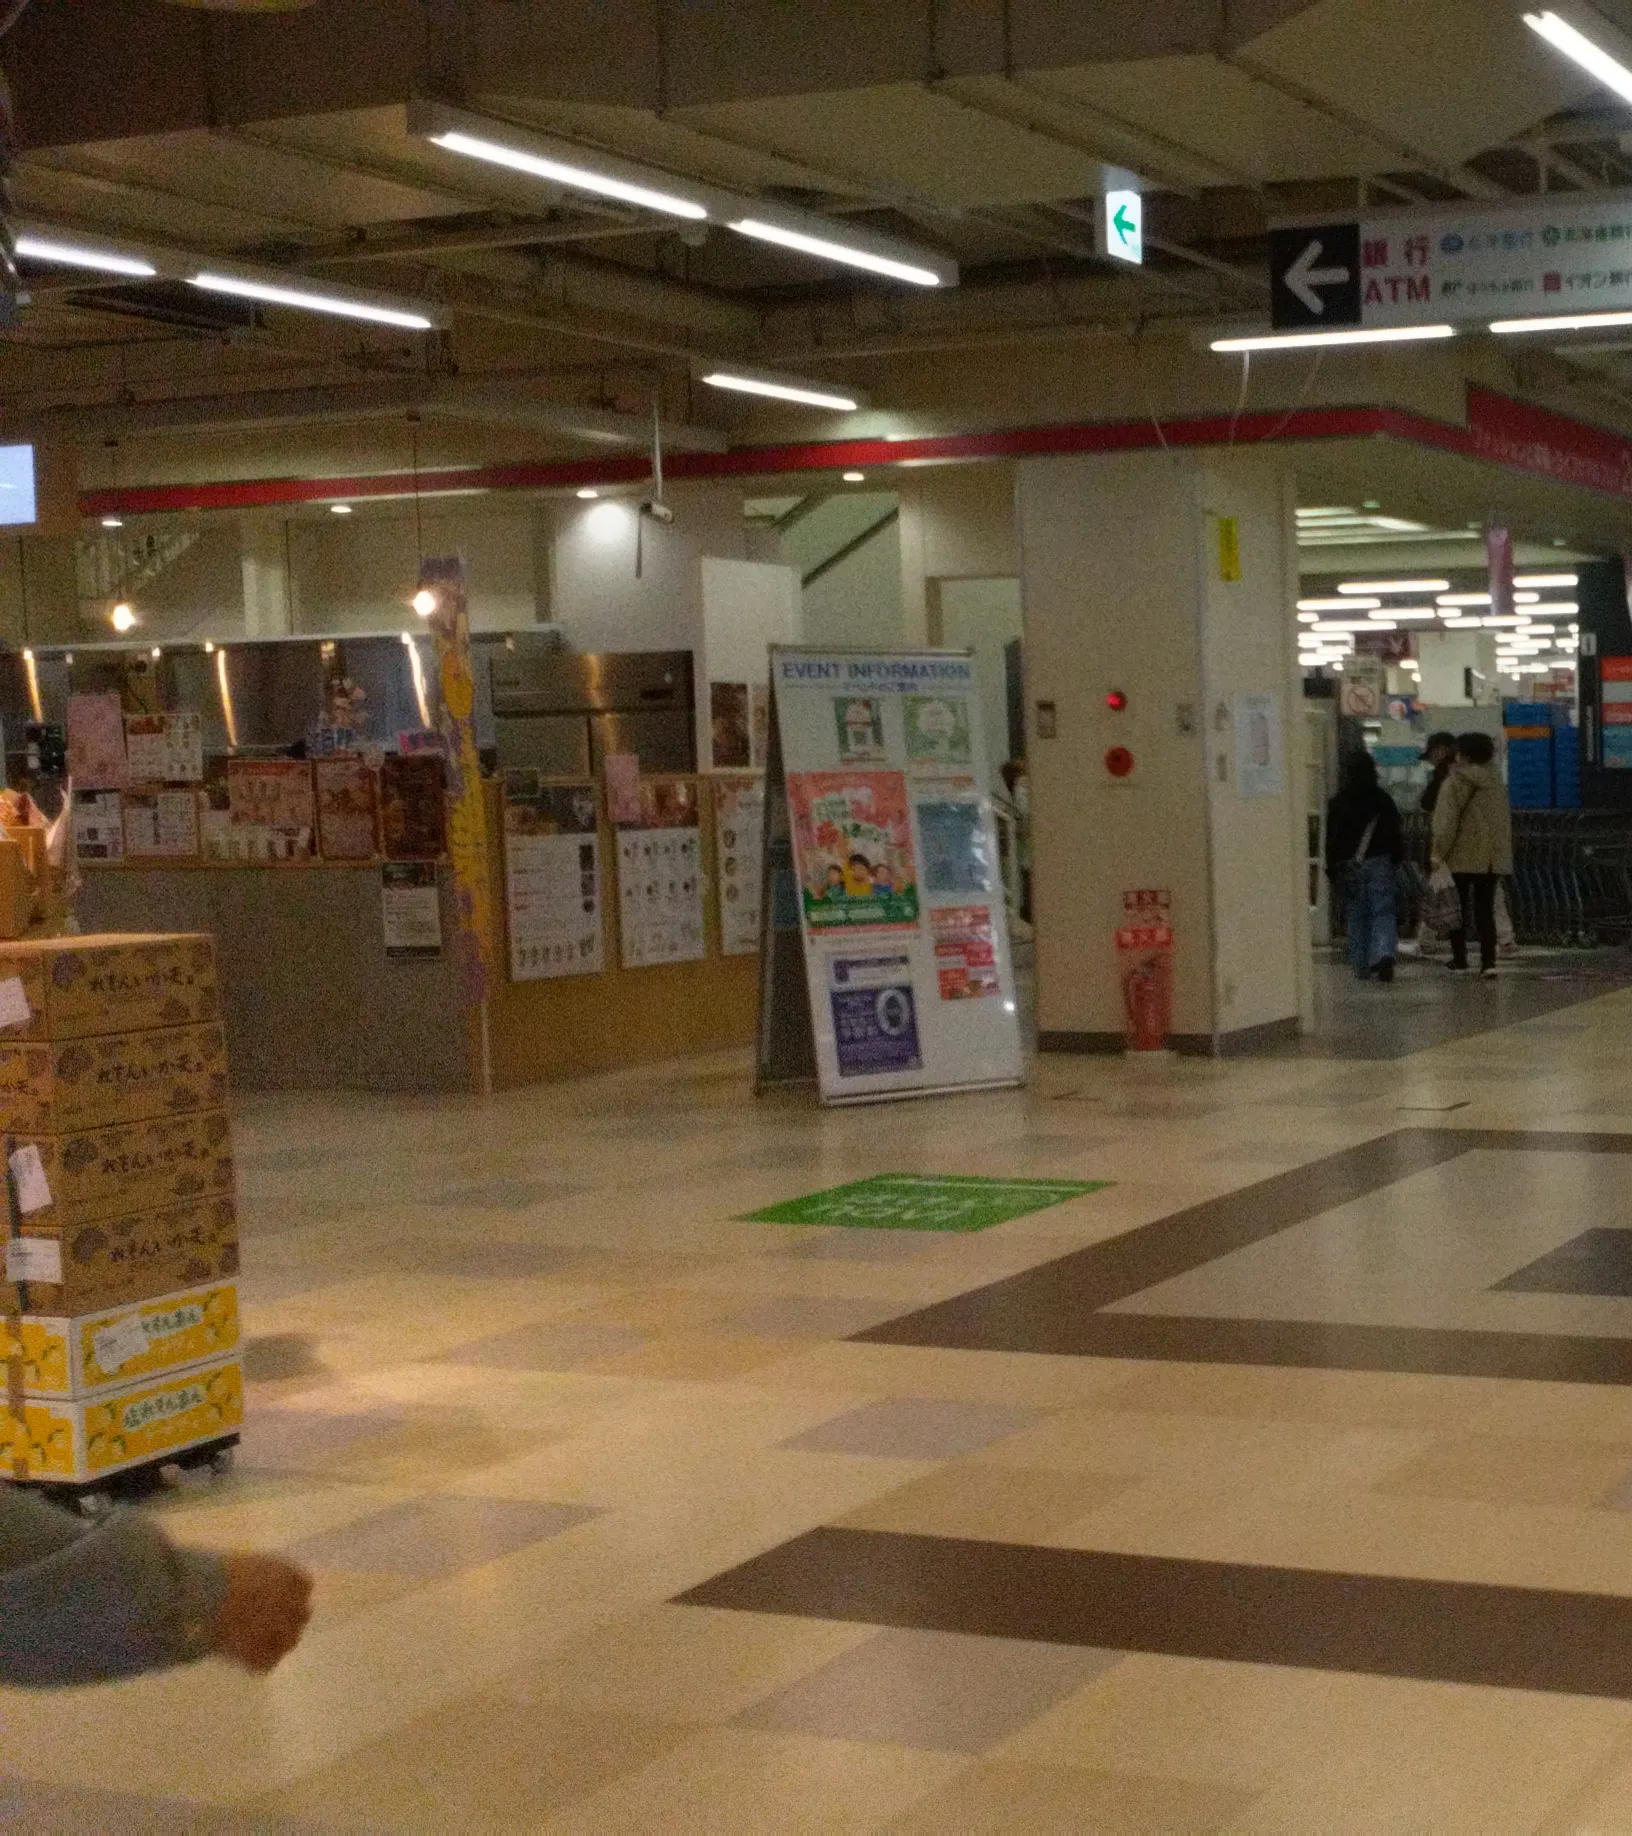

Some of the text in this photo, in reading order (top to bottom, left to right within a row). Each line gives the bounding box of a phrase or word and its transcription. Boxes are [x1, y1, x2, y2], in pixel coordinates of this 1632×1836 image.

[1363, 275, 1431, 304] ATM
[781, 661, 972, 681] EVENT INFORMATION
